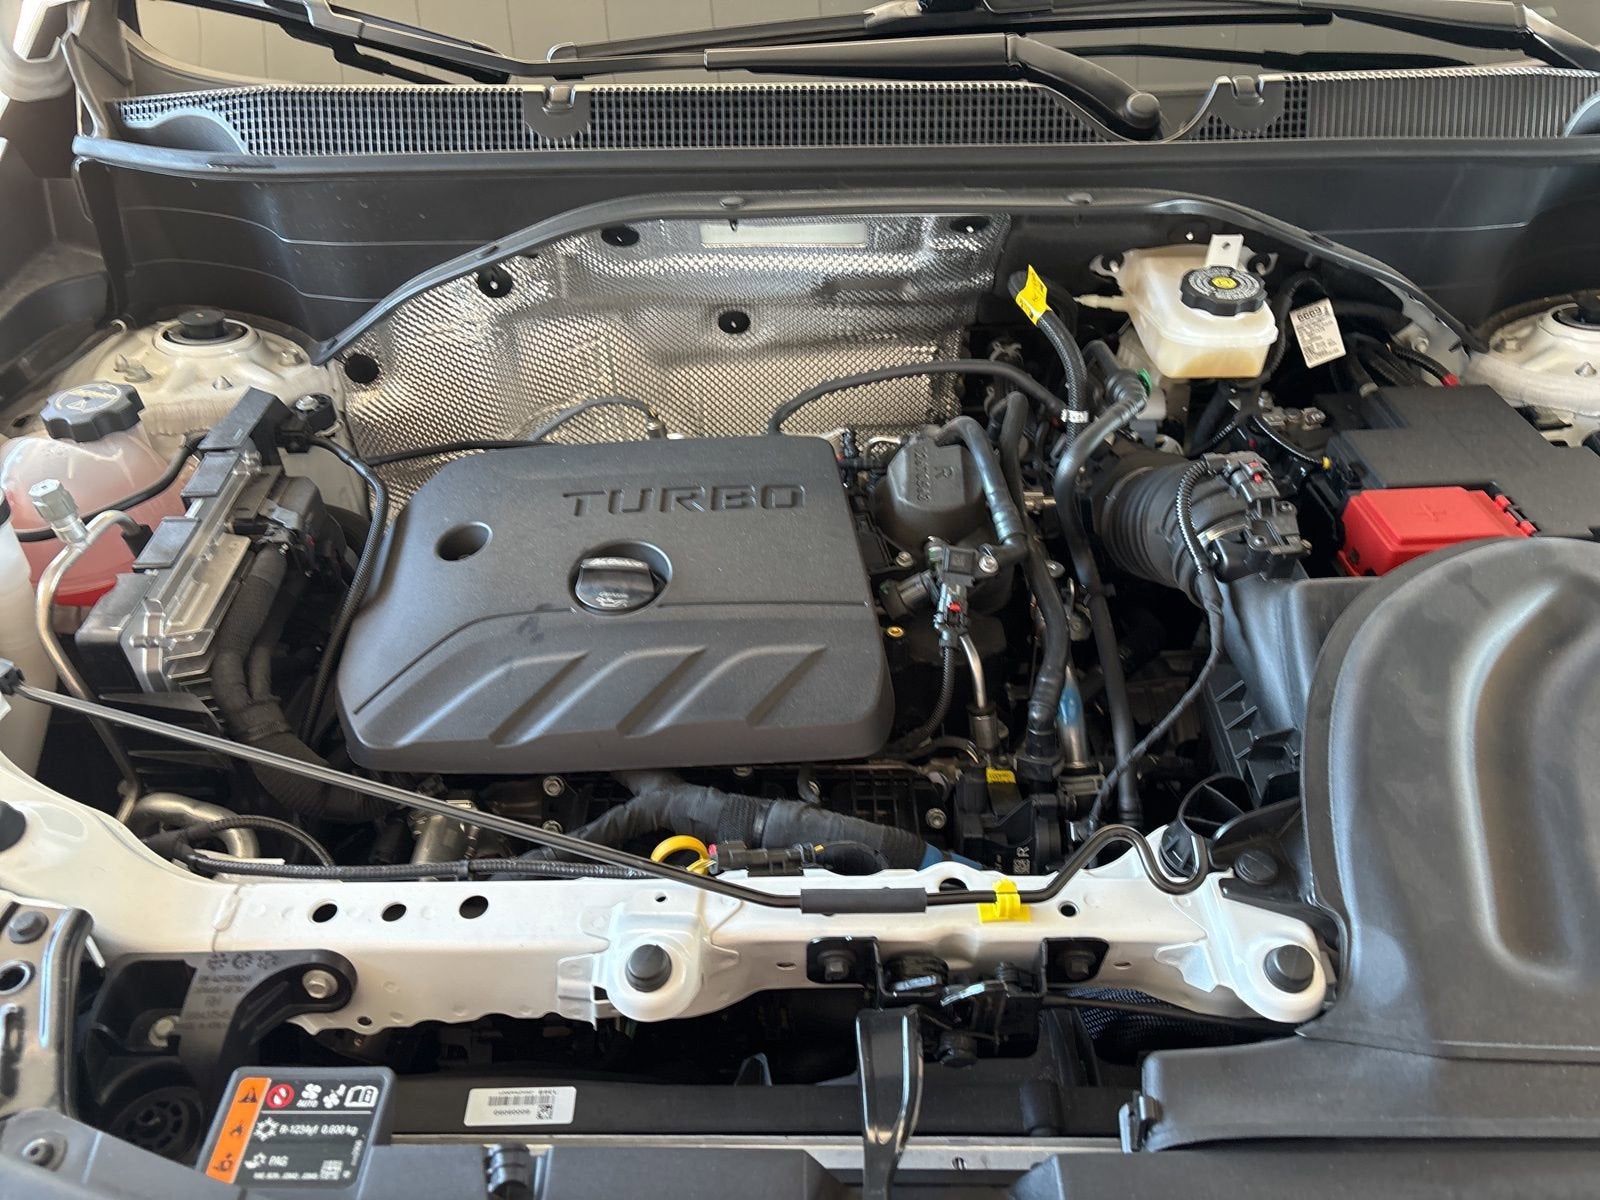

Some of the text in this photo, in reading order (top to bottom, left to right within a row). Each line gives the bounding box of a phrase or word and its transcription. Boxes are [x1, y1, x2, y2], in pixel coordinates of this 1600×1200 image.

[563, 483, 807, 517] TURBO
[296, 1099, 319, 1108] AUTO
[268, 1155, 289, 1167] PAG
